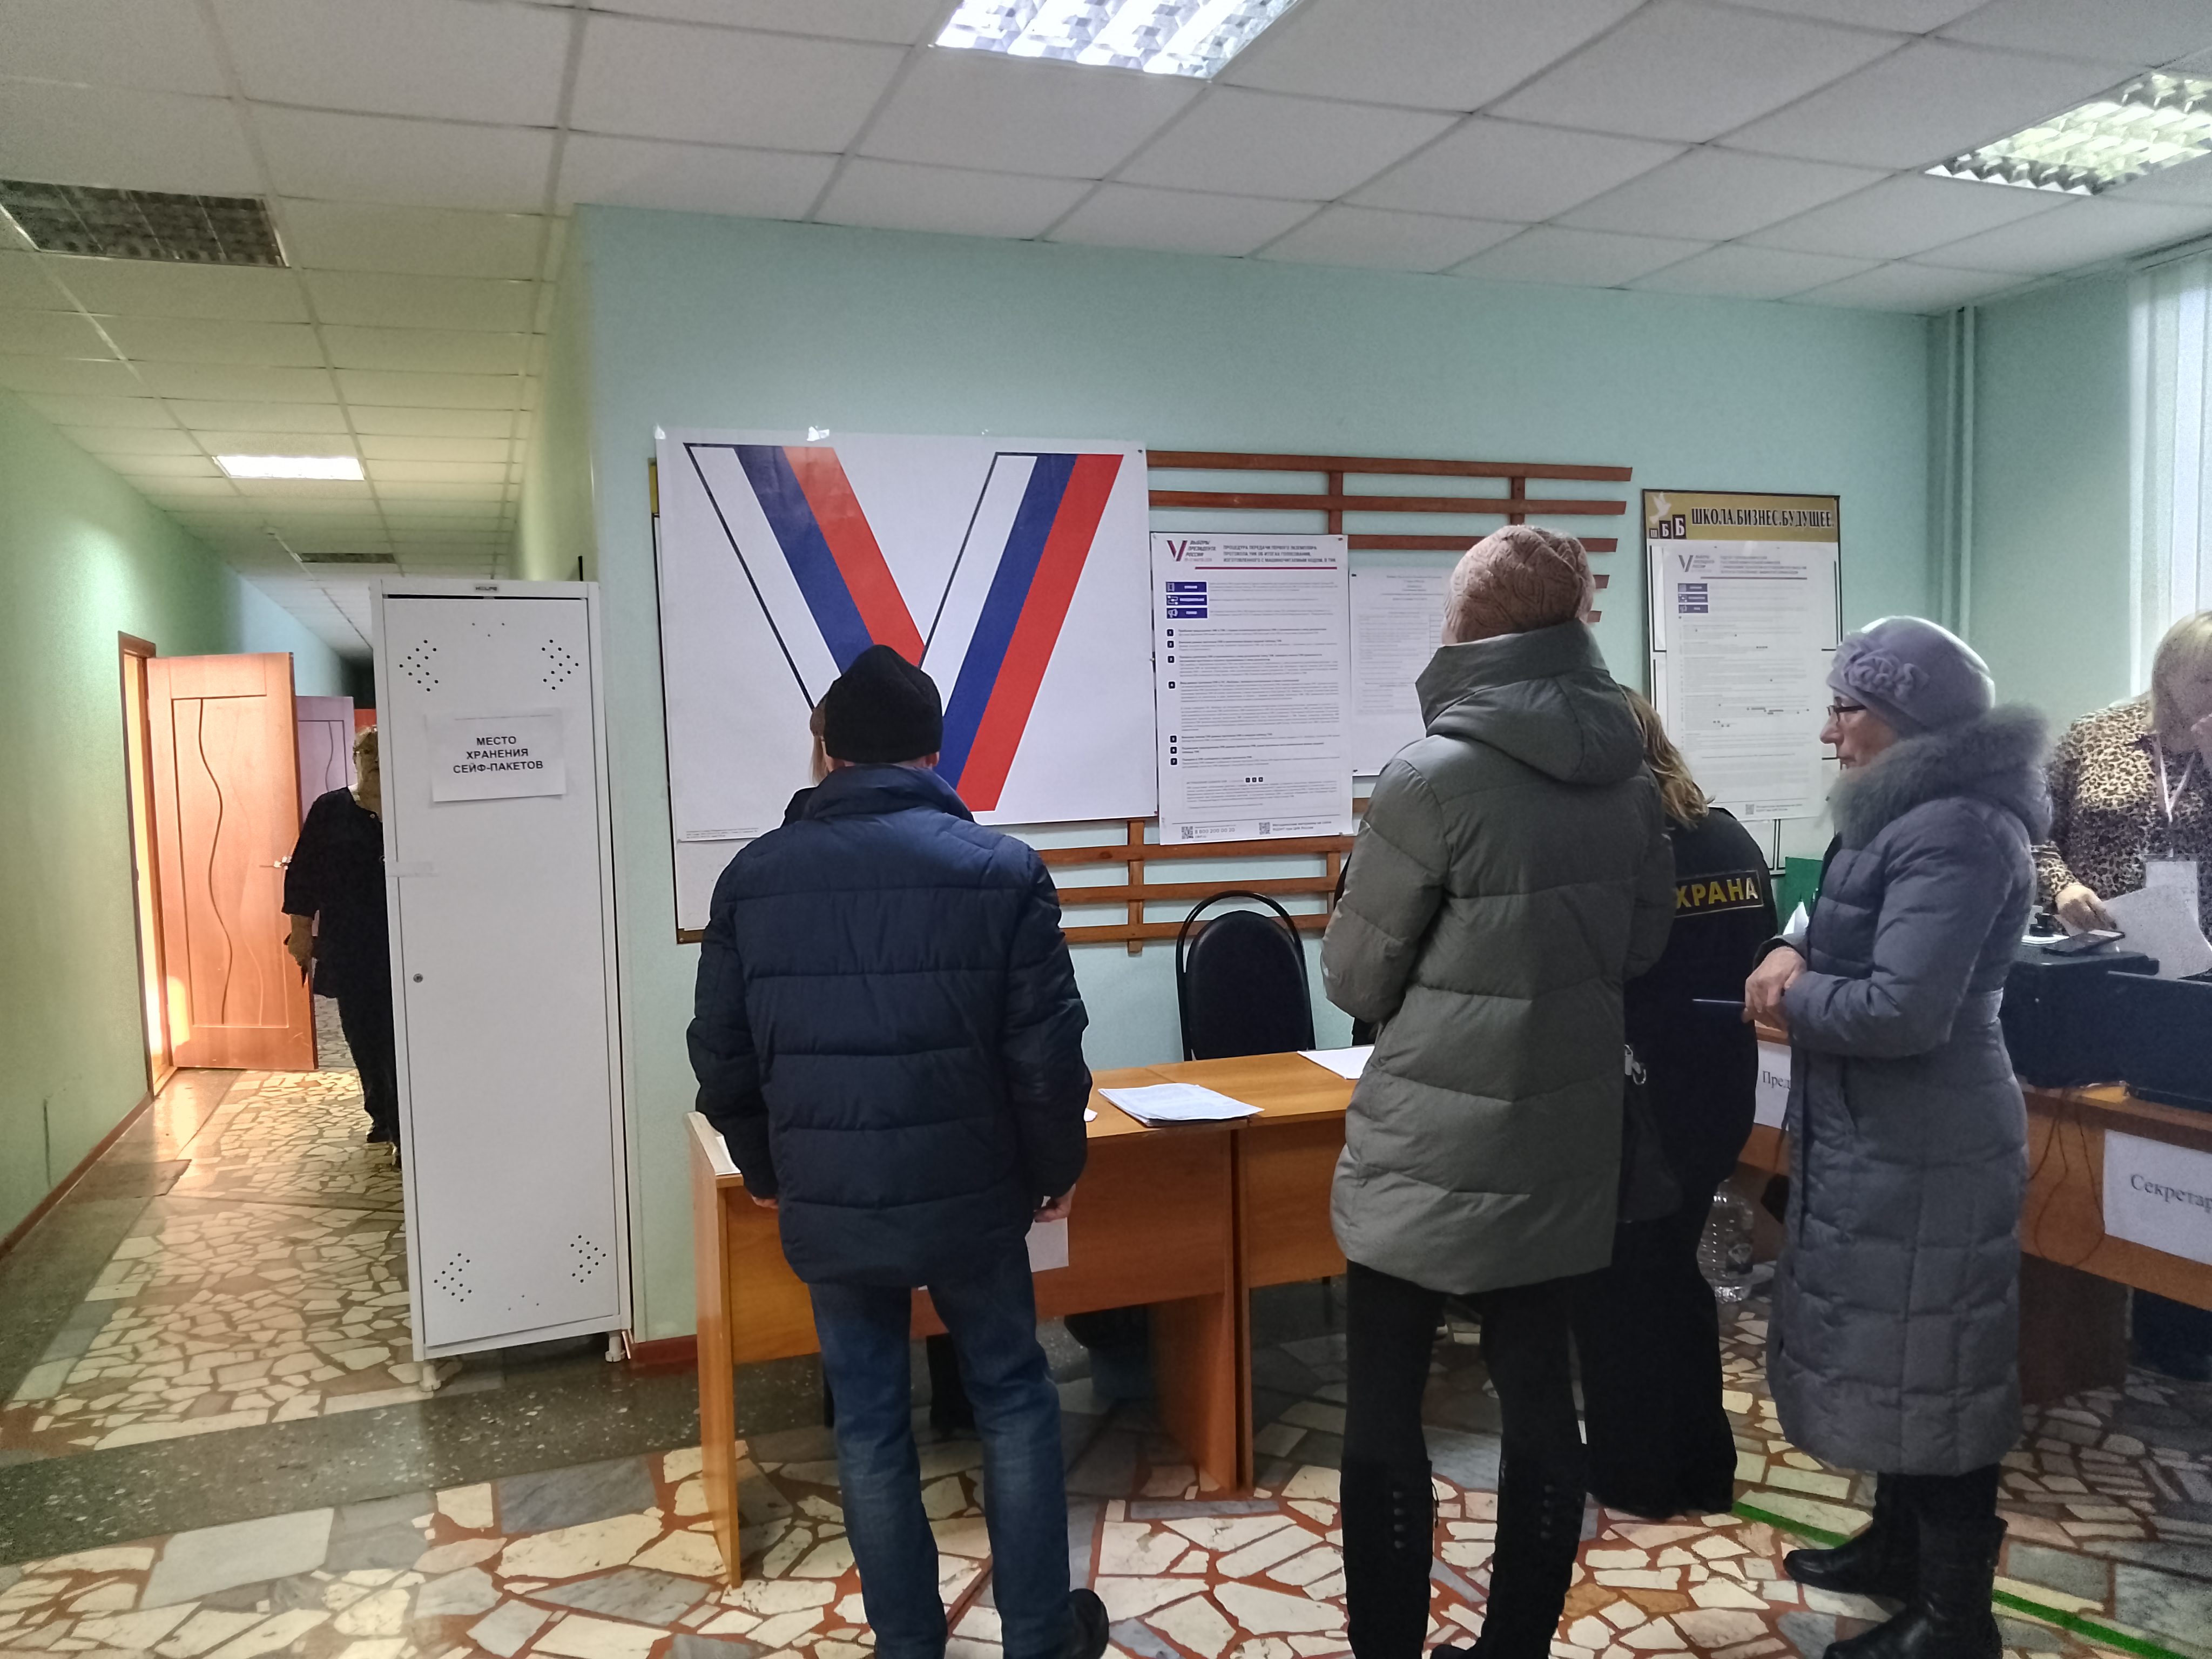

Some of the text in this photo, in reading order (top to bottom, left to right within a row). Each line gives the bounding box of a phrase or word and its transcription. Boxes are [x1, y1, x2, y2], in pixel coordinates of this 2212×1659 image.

[476, 736, 517, 746] МЕСТО
[466, 748, 529, 759] ХРАНЕНИЯ
[453, 760, 543, 773] СЕЙФ-ПАКЕТОВ
[1676, 877, 1758, 909] ХРАНА
